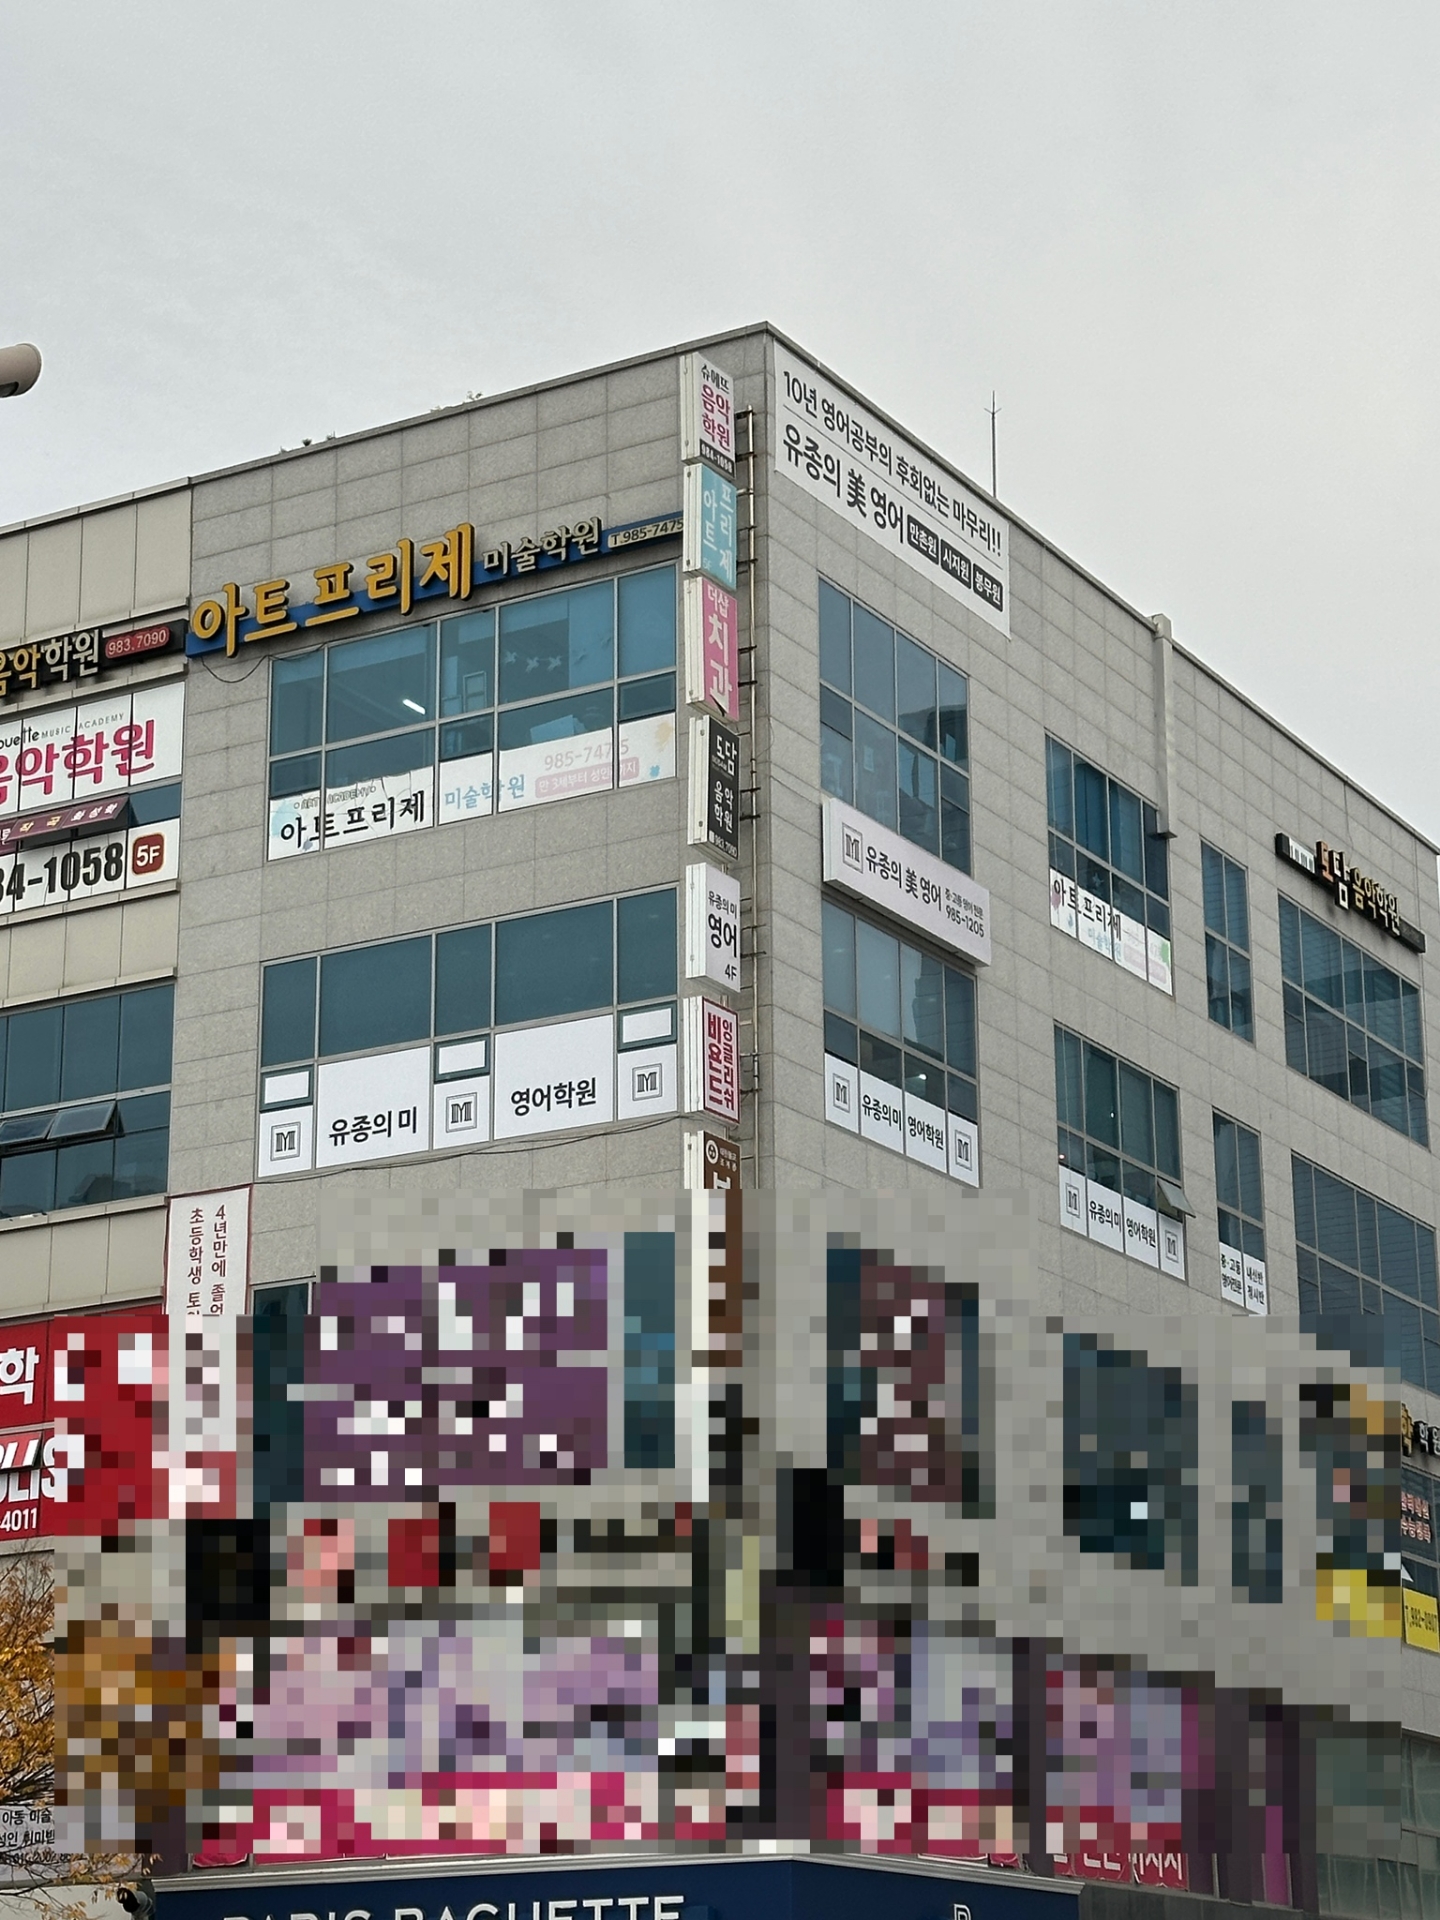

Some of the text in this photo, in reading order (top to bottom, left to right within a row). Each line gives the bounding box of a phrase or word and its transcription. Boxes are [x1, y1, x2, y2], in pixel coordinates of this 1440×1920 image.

[701, 384, 730, 425] 음악
[701, 414, 730, 453] 학원
[784, 371, 1001, 557] 10년 영어공부의 후회없는 마무리!!
[703, 489, 718, 551] 아트
[720, 483, 734, 583] 프리제
[784, 424, 1001, 605] 유종의 美 영어 만촌원 시지원 봉무원
[191, 522, 475, 658] 아트프리제
[483, 517, 602, 575] 미술학원
[109, 629, 166, 656] 983.7090
[708, 613, 733, 714] 치과
[41, 726, 71, 739] MUSIC
[79, 712, 125, 730] ACADEMY
[544, 738, 629, 771] 985-7475
[716, 735, 737, 776] 도담
[444, 774, 525, 811] 미술학원
[279, 790, 425, 850] 아트프리제
[0, 841, 161, 901] 4-1058 5F
[866, 846, 902, 889] 유종의
[906, 867, 918, 899] 美
[920, 877, 942, 912] 영어
[946, 904, 985, 938] 985-1205
[1054, 878, 1122, 942] 아트프리제
[1352, 867, 1401, 936] 음악학원
[708, 913, 737, 958] 영어
[724, 963, 738, 981] 4F
[510, 1077, 597, 1117] 영어학원
[907, 1116, 944, 1151] 영어학원
[187, 1208, 204, 1285] 초등학생
[211, 1204, 228, 1278] 4년만에
[1126, 1217, 1156, 1248] 영어학원
[0, 1507, 37, 1533] 4011
[2, 1808, 52, 1826] 아동 미술
